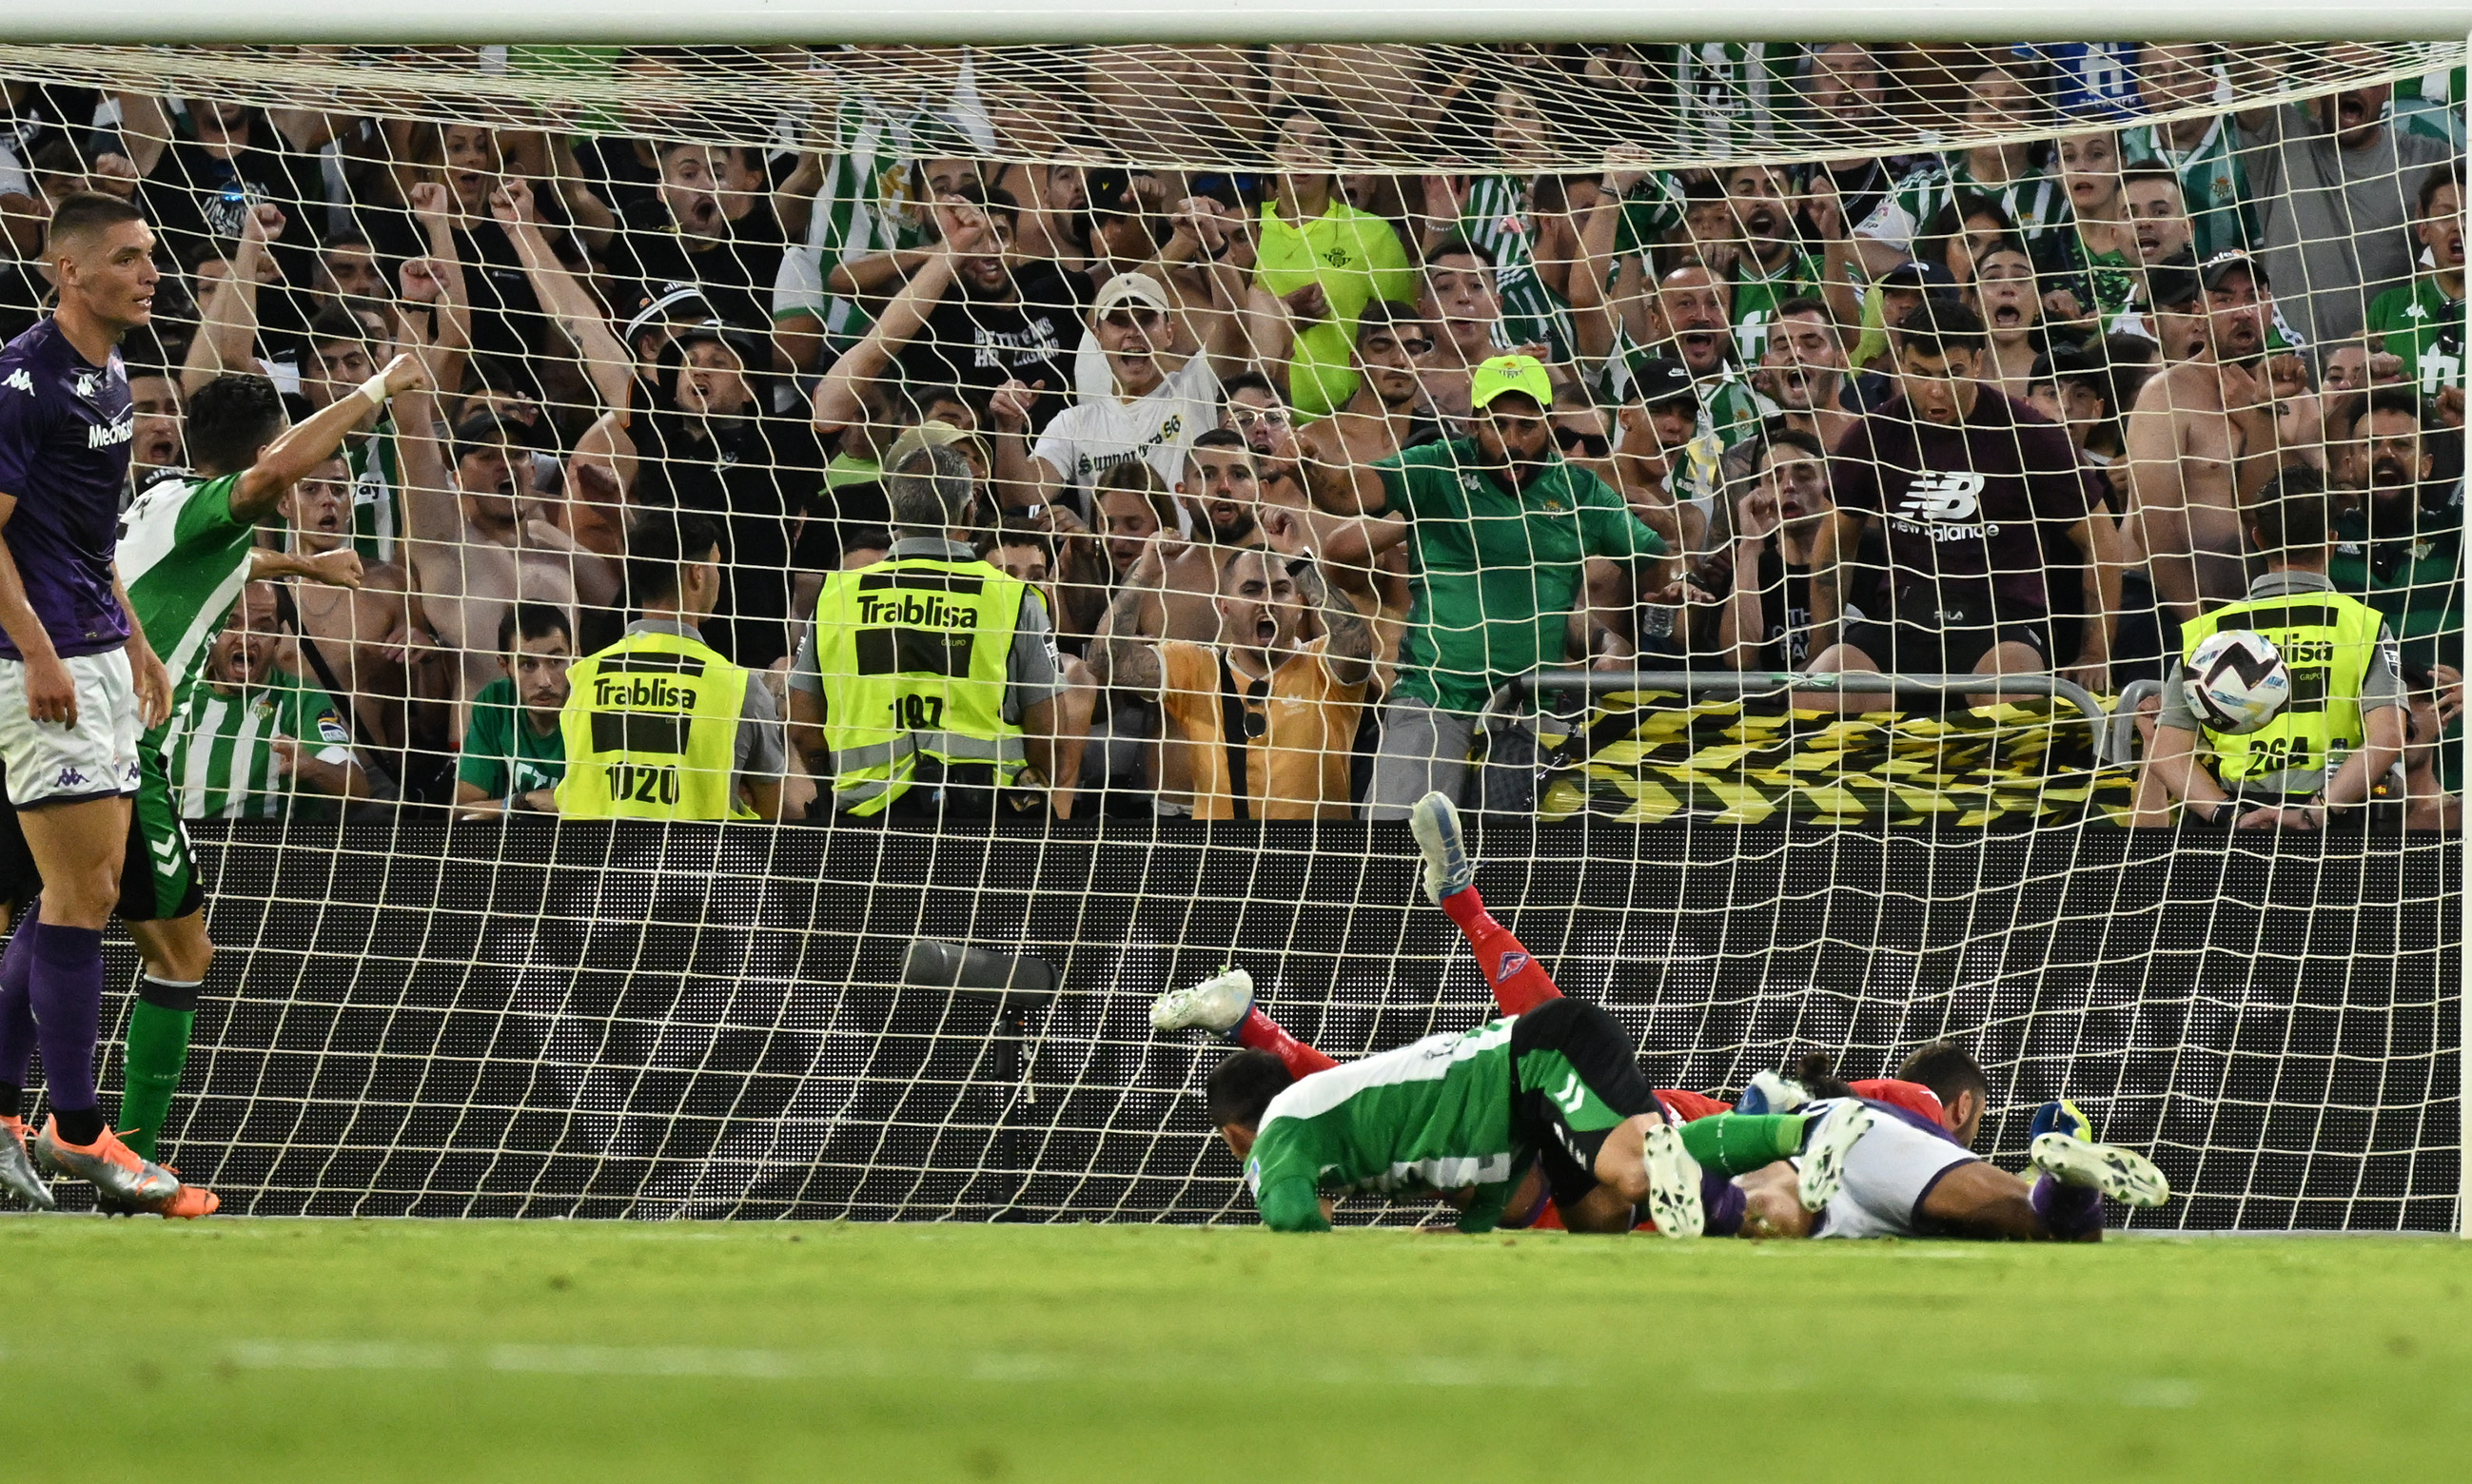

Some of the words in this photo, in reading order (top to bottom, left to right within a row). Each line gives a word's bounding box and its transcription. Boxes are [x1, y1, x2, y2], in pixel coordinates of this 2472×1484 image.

[856, 595, 978, 629] Trablisa
[594, 678, 696, 710] Trablisa
[2245, 736, 2310, 776] 264
[605, 761, 679, 806] 1020
